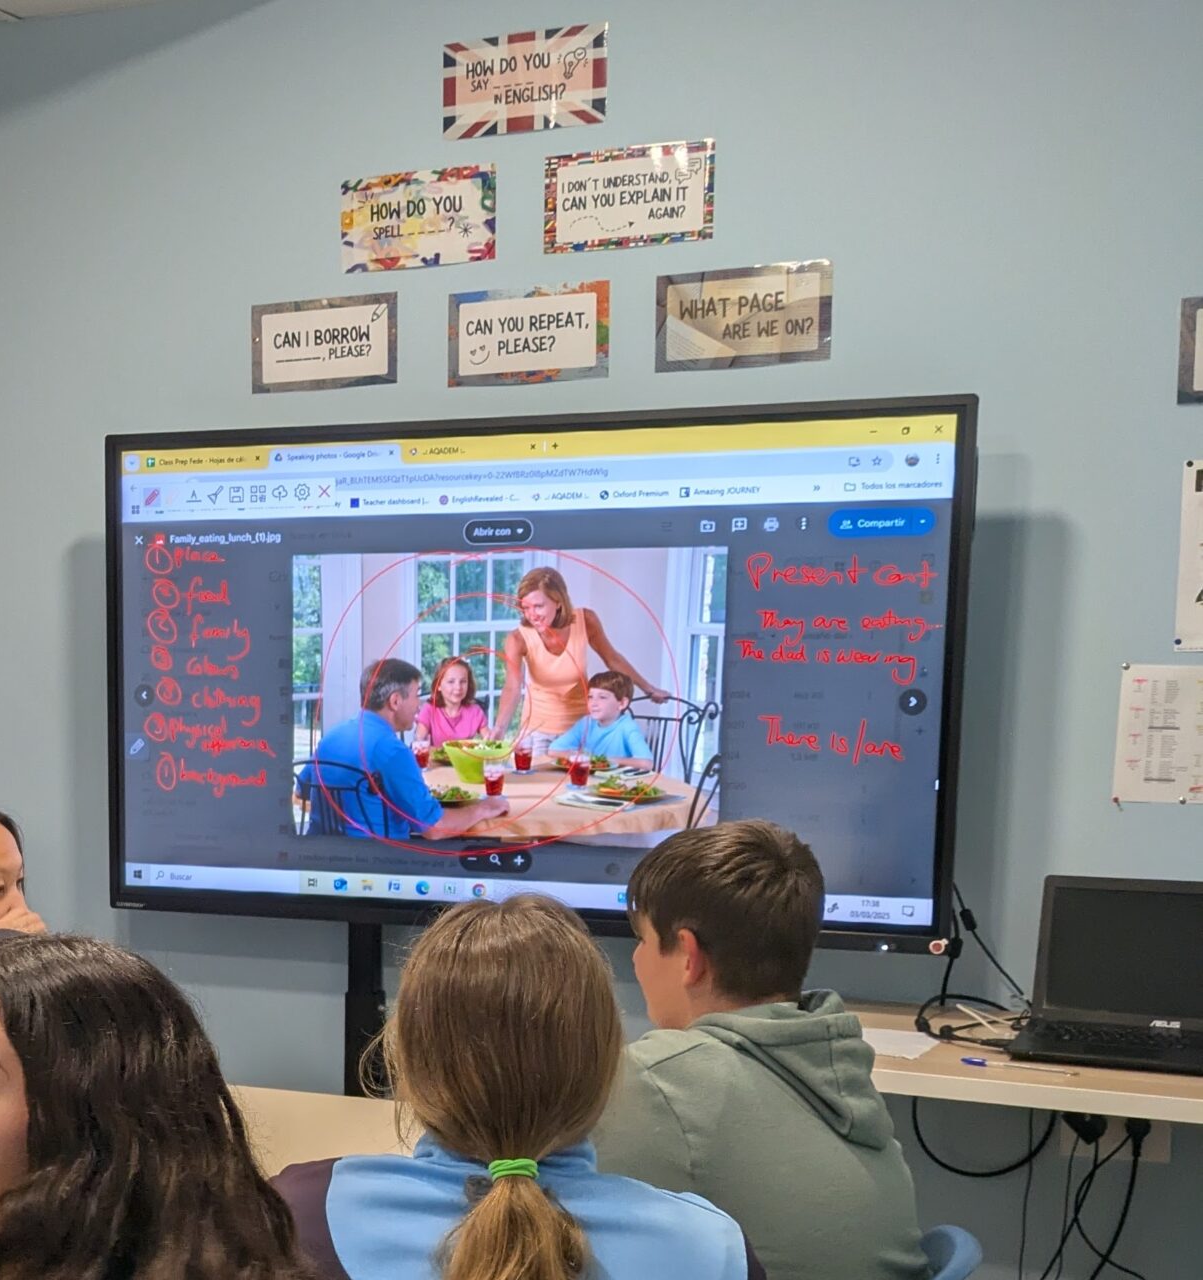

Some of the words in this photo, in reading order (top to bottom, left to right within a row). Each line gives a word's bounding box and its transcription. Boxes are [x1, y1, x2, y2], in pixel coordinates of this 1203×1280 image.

[465, 61, 495, 80] HOW
[499, 55, 518, 75] DO
[522, 51, 551, 72] YOU
[470, 78, 490, 93] SAY
[493, 93, 503, 105] IN
[504, 82, 566, 106] ENGLISH?
[562, 182, 566, 194] I
[602, 171, 673, 189] UNDERSTAND,
[370, 201, 401, 223] HOW
[406, 198, 426, 218] DO
[432, 195, 463, 215] YOU
[562, 195, 587, 212] CAN
[591, 193, 616, 208] YOU
[619, 187, 672, 206] EXPLAIN
[675, 185, 689, 201] IT
[647, 204, 686, 221] AGAIN?
[372, 224, 403, 241] SPELL
[679, 297, 731, 321] WHAT
[737, 290, 786, 316] PAGE
[465, 318, 493, 337] CAN
[497, 316, 525, 334] YOU
[528, 310, 589, 332] REPEAT,
[722, 321, 751, 341] ARE
[756, 319, 779, 338] WE
[784, 316, 814, 336] ON?
[273, 330, 301, 350] CAN
[305, 330, 309, 347] I
[313, 324, 370, 347] BORROW
[497, 335, 556, 356] PLEASE?
[328, 343, 372, 361] PLEASE?
[287, 453, 315, 462] Speaking
[316, 451, 337, 461] photos
[343, 450, 367, 461] Google
[612, 489, 636, 499] Oxford
[638, 488, 669, 498] Premium
[694, 486, 725, 498] Amazing
[727, 485, 761, 495] JOURNEY
[861, 481, 882, 491] Todos
[884, 480, 896, 490] los
[897, 479, 943, 490] marcadores
[473, 527, 495, 537] Abrir
[495, 528, 512, 536] con
[856, 516, 906, 530] Compartir
[746, 552, 868, 592] Present
[756, 609, 805, 647] They
[812, 615, 849, 632] are
[734, 639, 765, 661] The
[770, 645, 808, 664] dad
[816, 649, 830, 664] is
[835, 648, 917, 686] wearing
[757, 715, 821, 752] There
[170, 871, 192, 880] Buscar
[861, 899, 880, 908] 17:38
